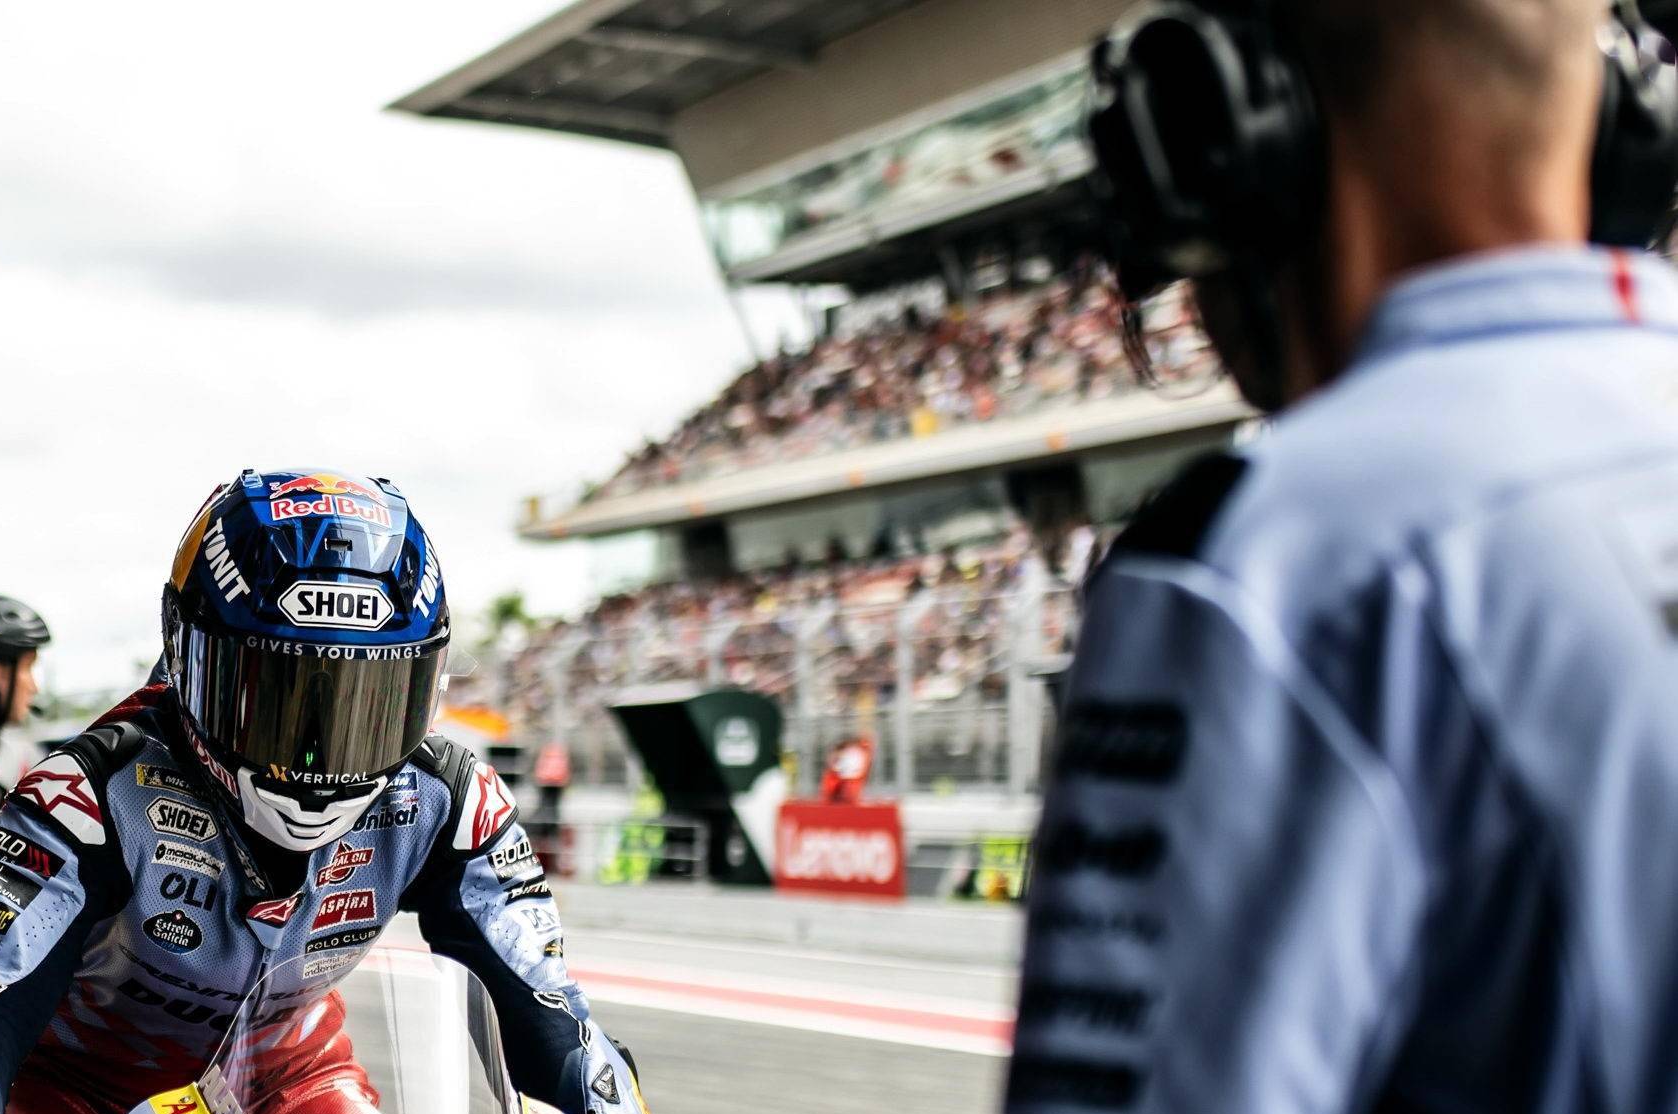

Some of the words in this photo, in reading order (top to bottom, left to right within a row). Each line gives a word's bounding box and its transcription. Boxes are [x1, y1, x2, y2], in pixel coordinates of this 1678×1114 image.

[273, 496, 331, 518] Red
[337, 498, 389, 525] Bull
[203, 519, 249, 603] TONIT
[297, 590, 379, 621] SHOEI
[247, 635, 303, 656] GIVES
[315, 646, 355, 661] YOU
[366, 645, 422, 661] WINGS
[290, 770, 369, 785] VERTICAL
[157, 804, 211, 838] SHOEI
[160, 872, 218, 912] OLI
[319, 894, 369, 917] ASPIRA
[153, 928, 190, 947] Galicia
[156, 918, 194, 938] Estrella
[307, 936, 339, 954] POLO
